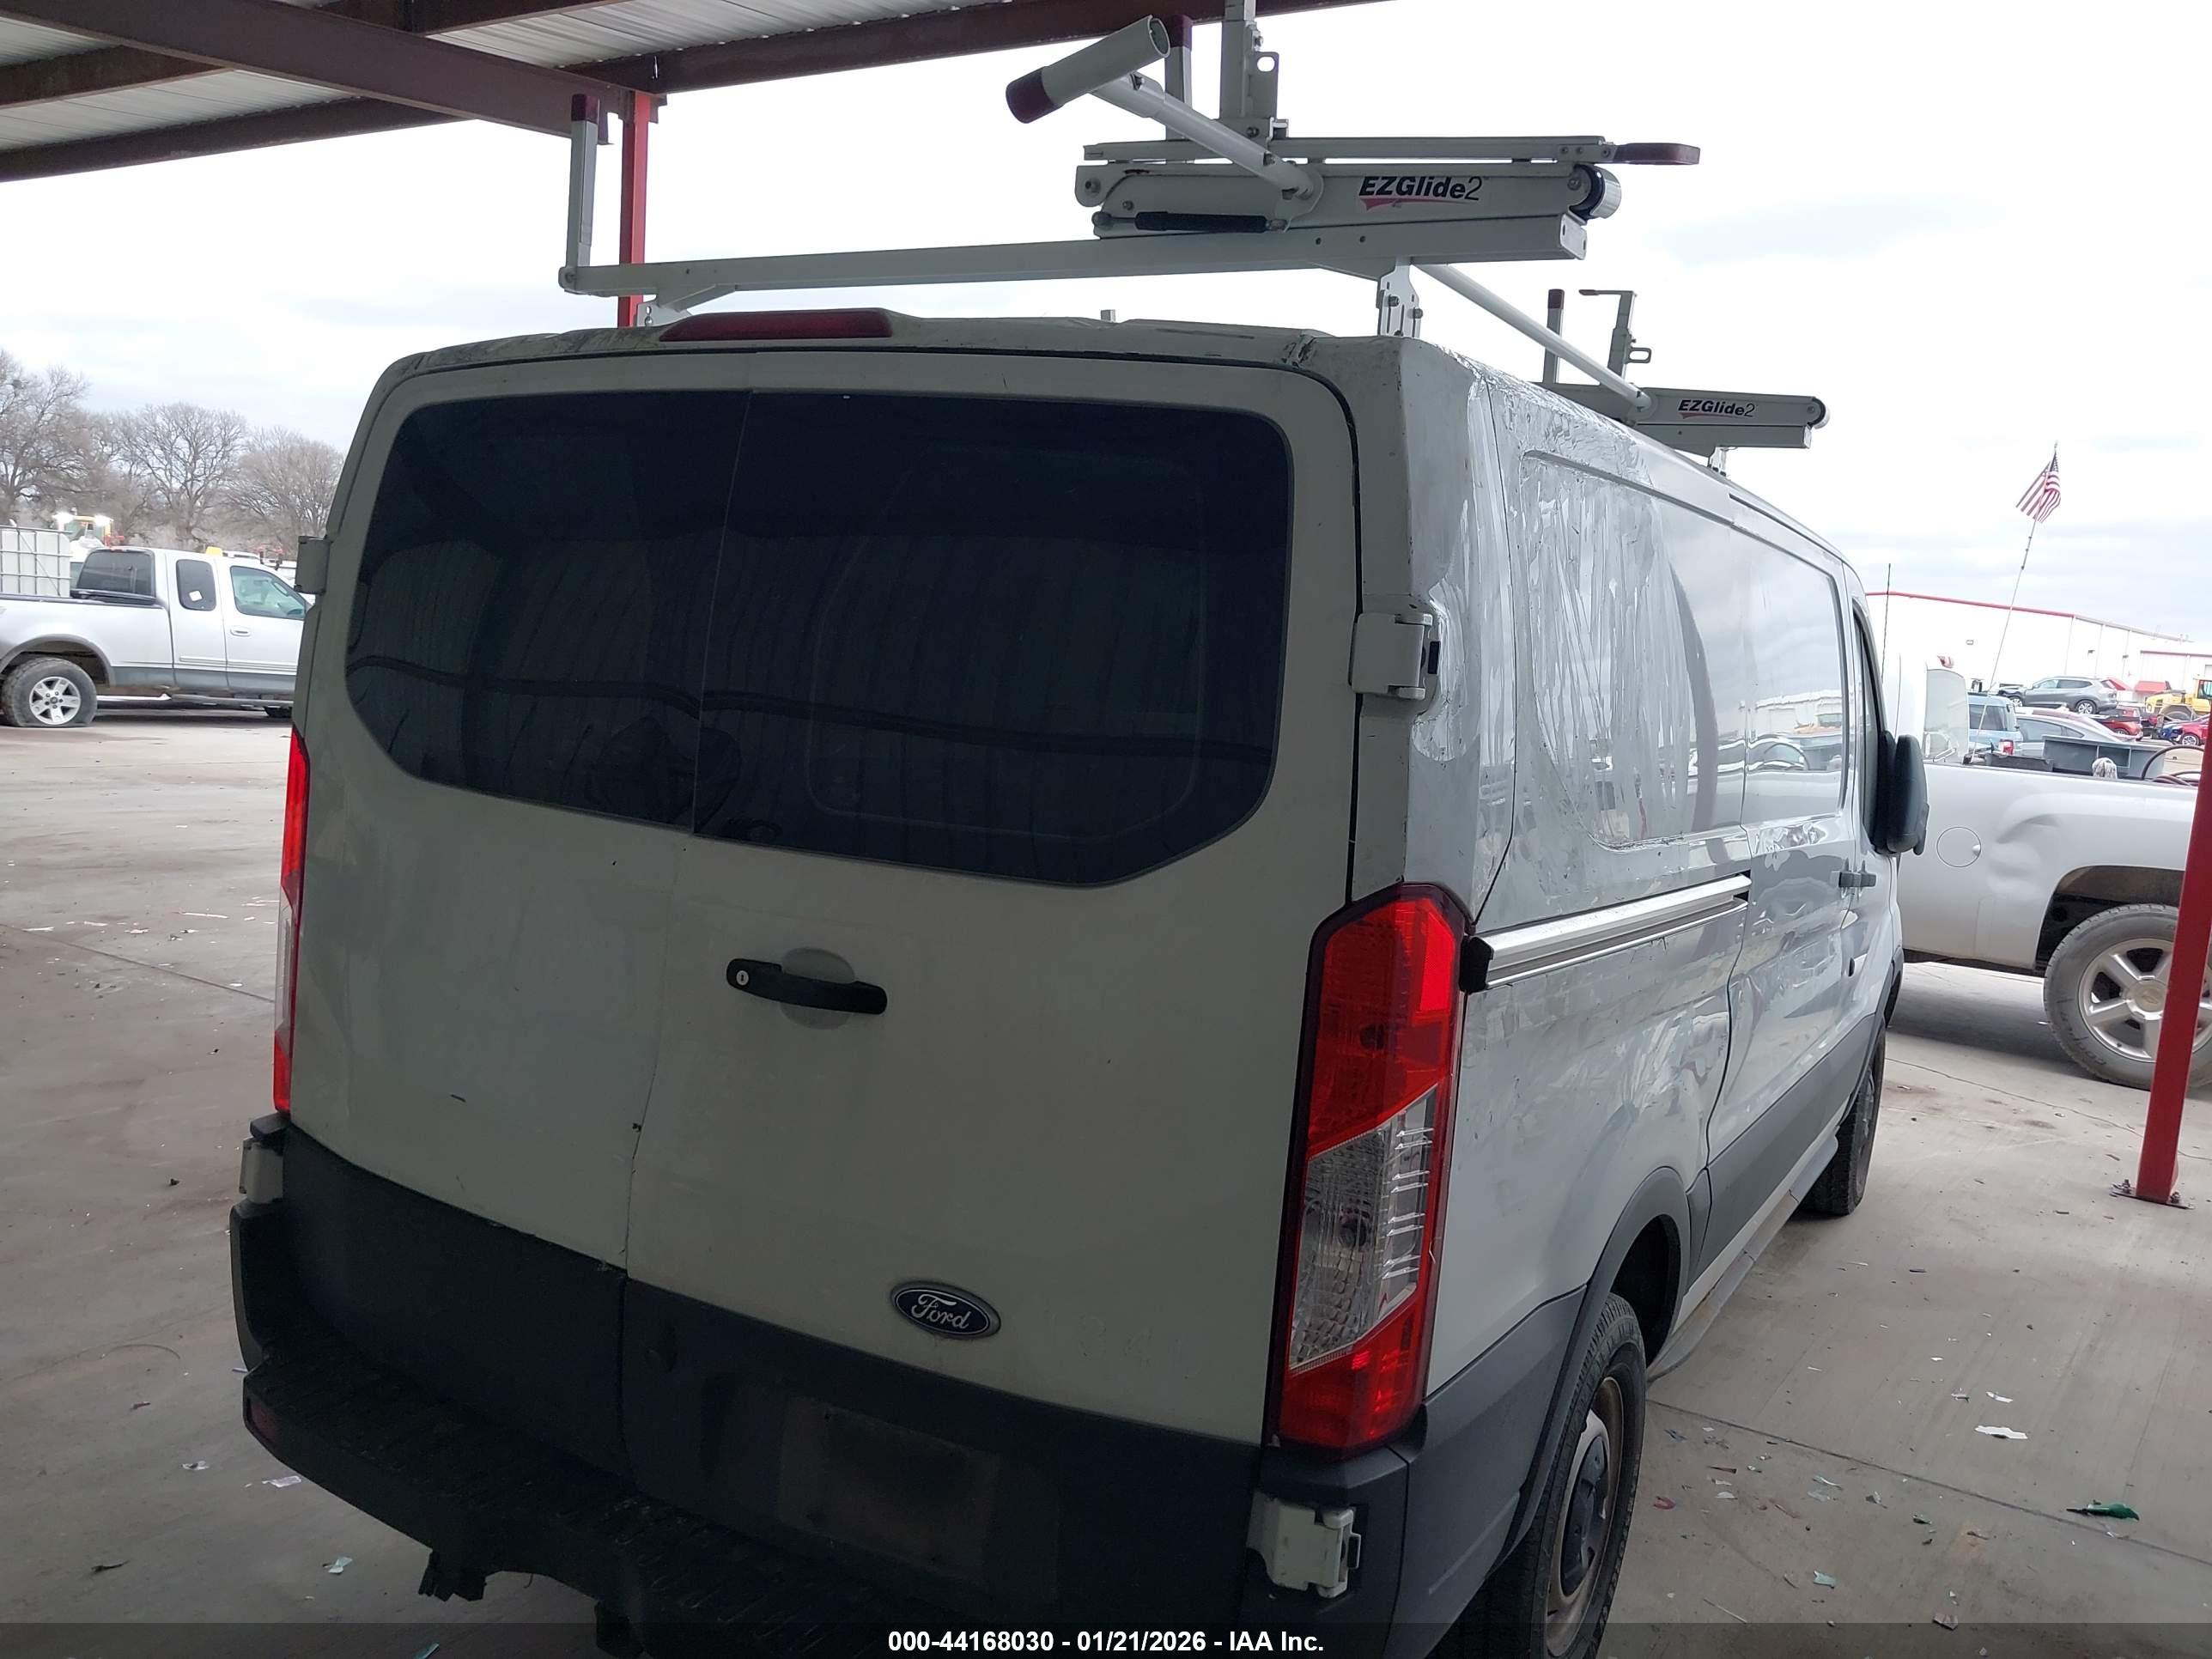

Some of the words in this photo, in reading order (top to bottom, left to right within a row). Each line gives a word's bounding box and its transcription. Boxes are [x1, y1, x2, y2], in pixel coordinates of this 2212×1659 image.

[1358, 176, 1482, 201] EZGlide2
[1678, 399, 1755, 417] EZGlide2
[911, 1293, 971, 1329] Ford
